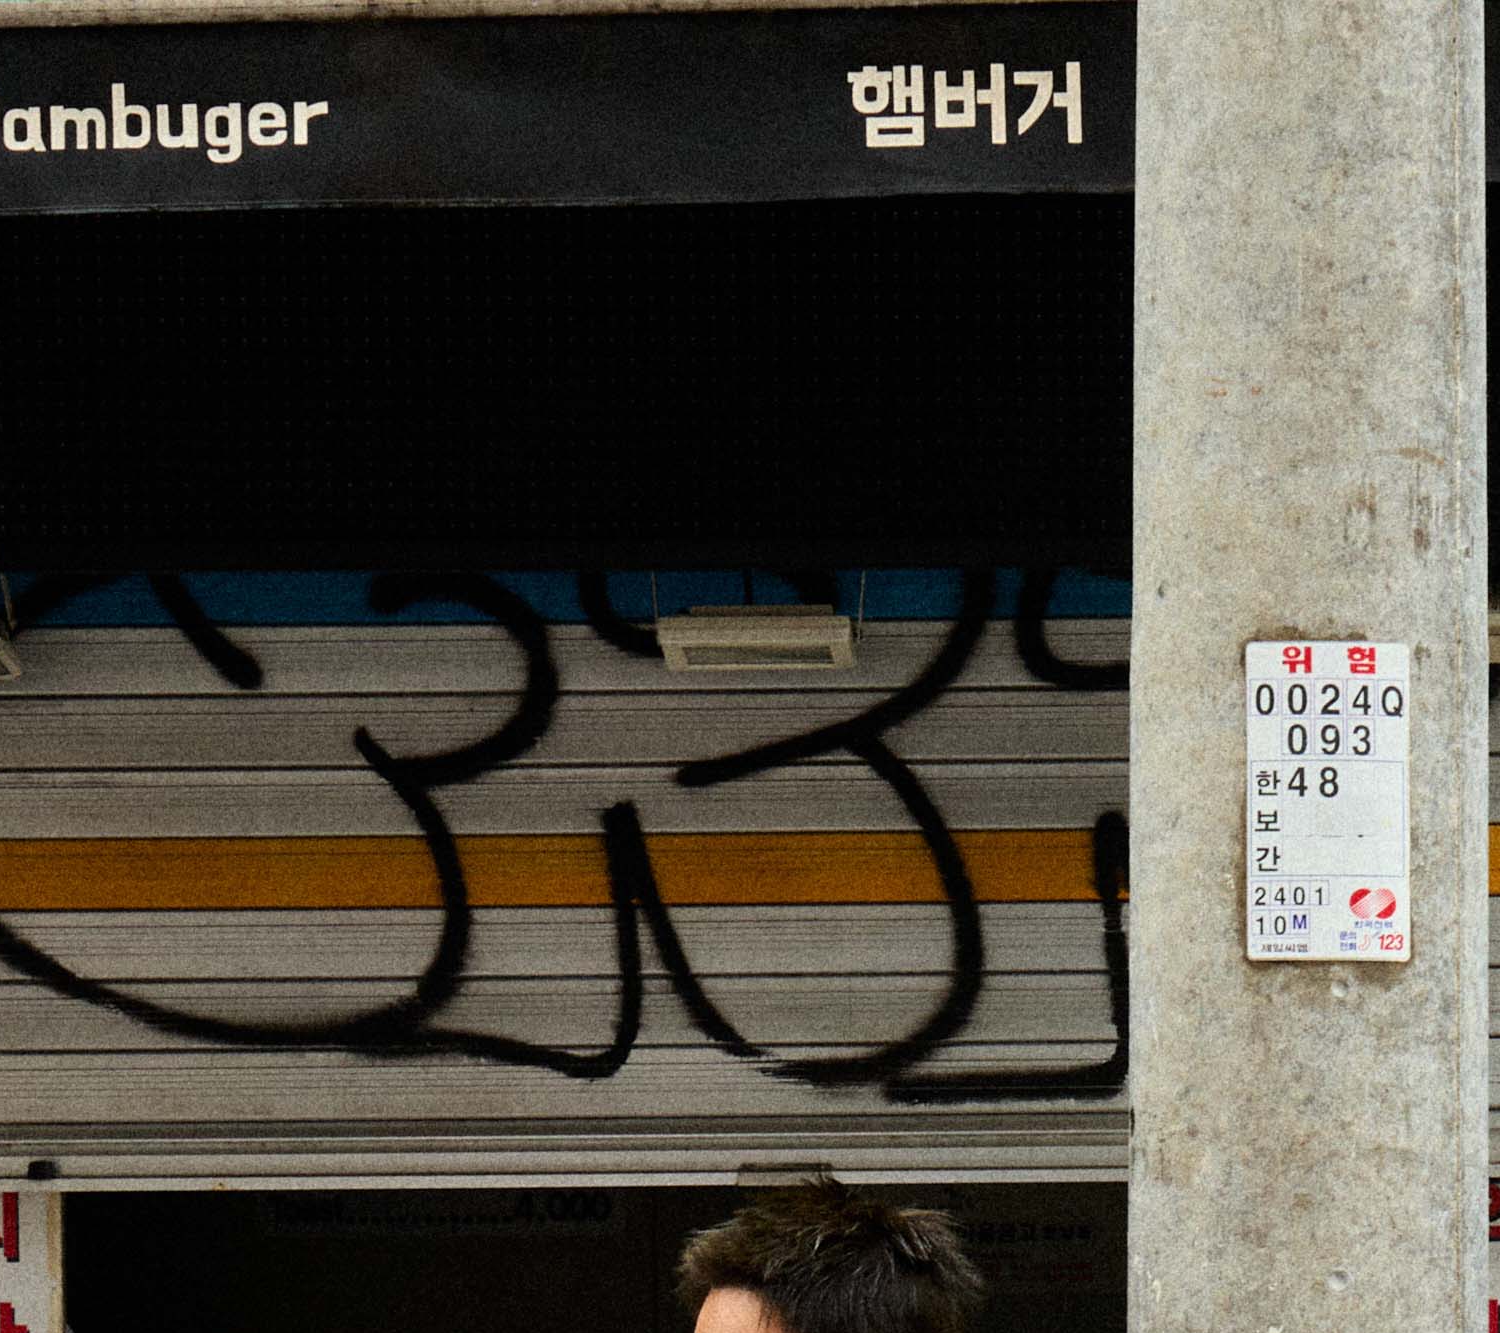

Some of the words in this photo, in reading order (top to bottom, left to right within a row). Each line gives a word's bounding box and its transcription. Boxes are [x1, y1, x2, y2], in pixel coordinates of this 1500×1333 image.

[848, 62, 1084, 146] 햄버거
[1287, 724, 1372, 756] 093
[1288, 766, 1339, 798] 48
[1255, 887, 1323, 906] 2401
[1256, 914, 1307, 935] 10M
[1379, 934, 1404, 951] 123
